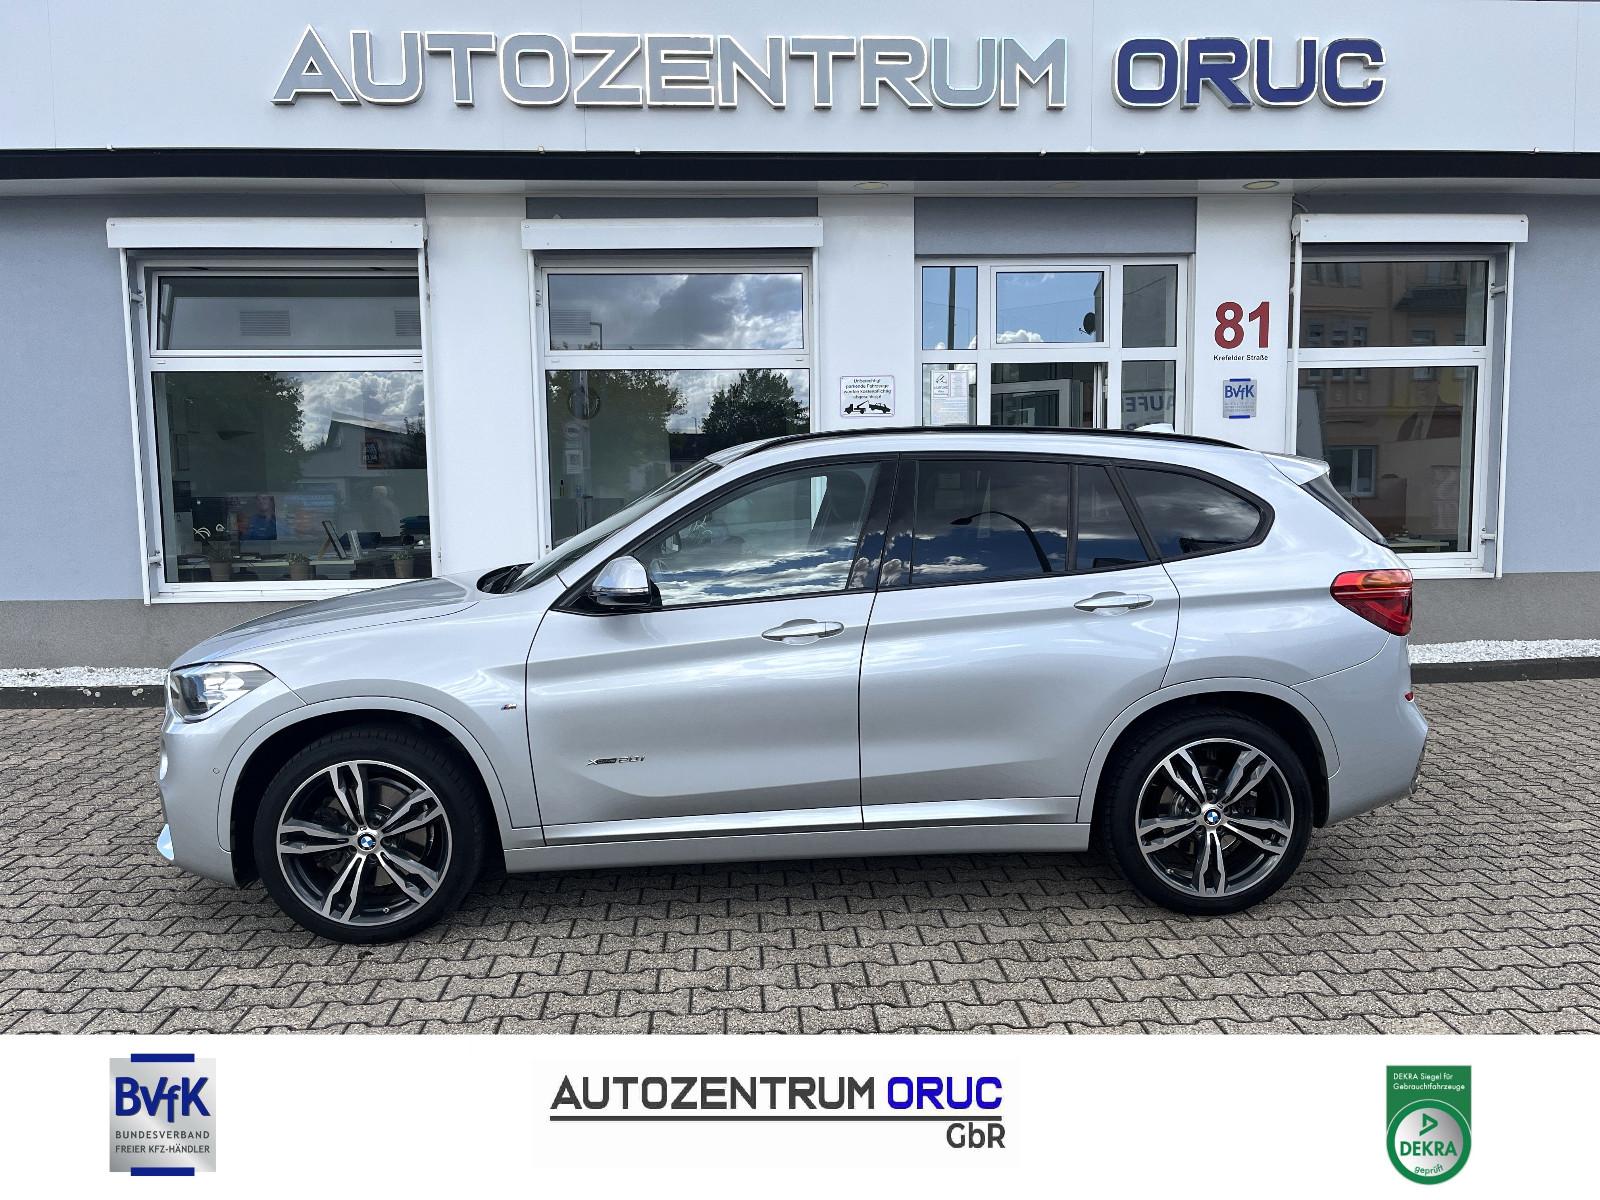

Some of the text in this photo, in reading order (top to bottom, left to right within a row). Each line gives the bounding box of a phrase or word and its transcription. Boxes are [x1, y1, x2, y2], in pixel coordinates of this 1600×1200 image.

[271, 23, 1386, 110] AUTOZENTRUM ORUC
[1214, 301, 1270, 349] 81
